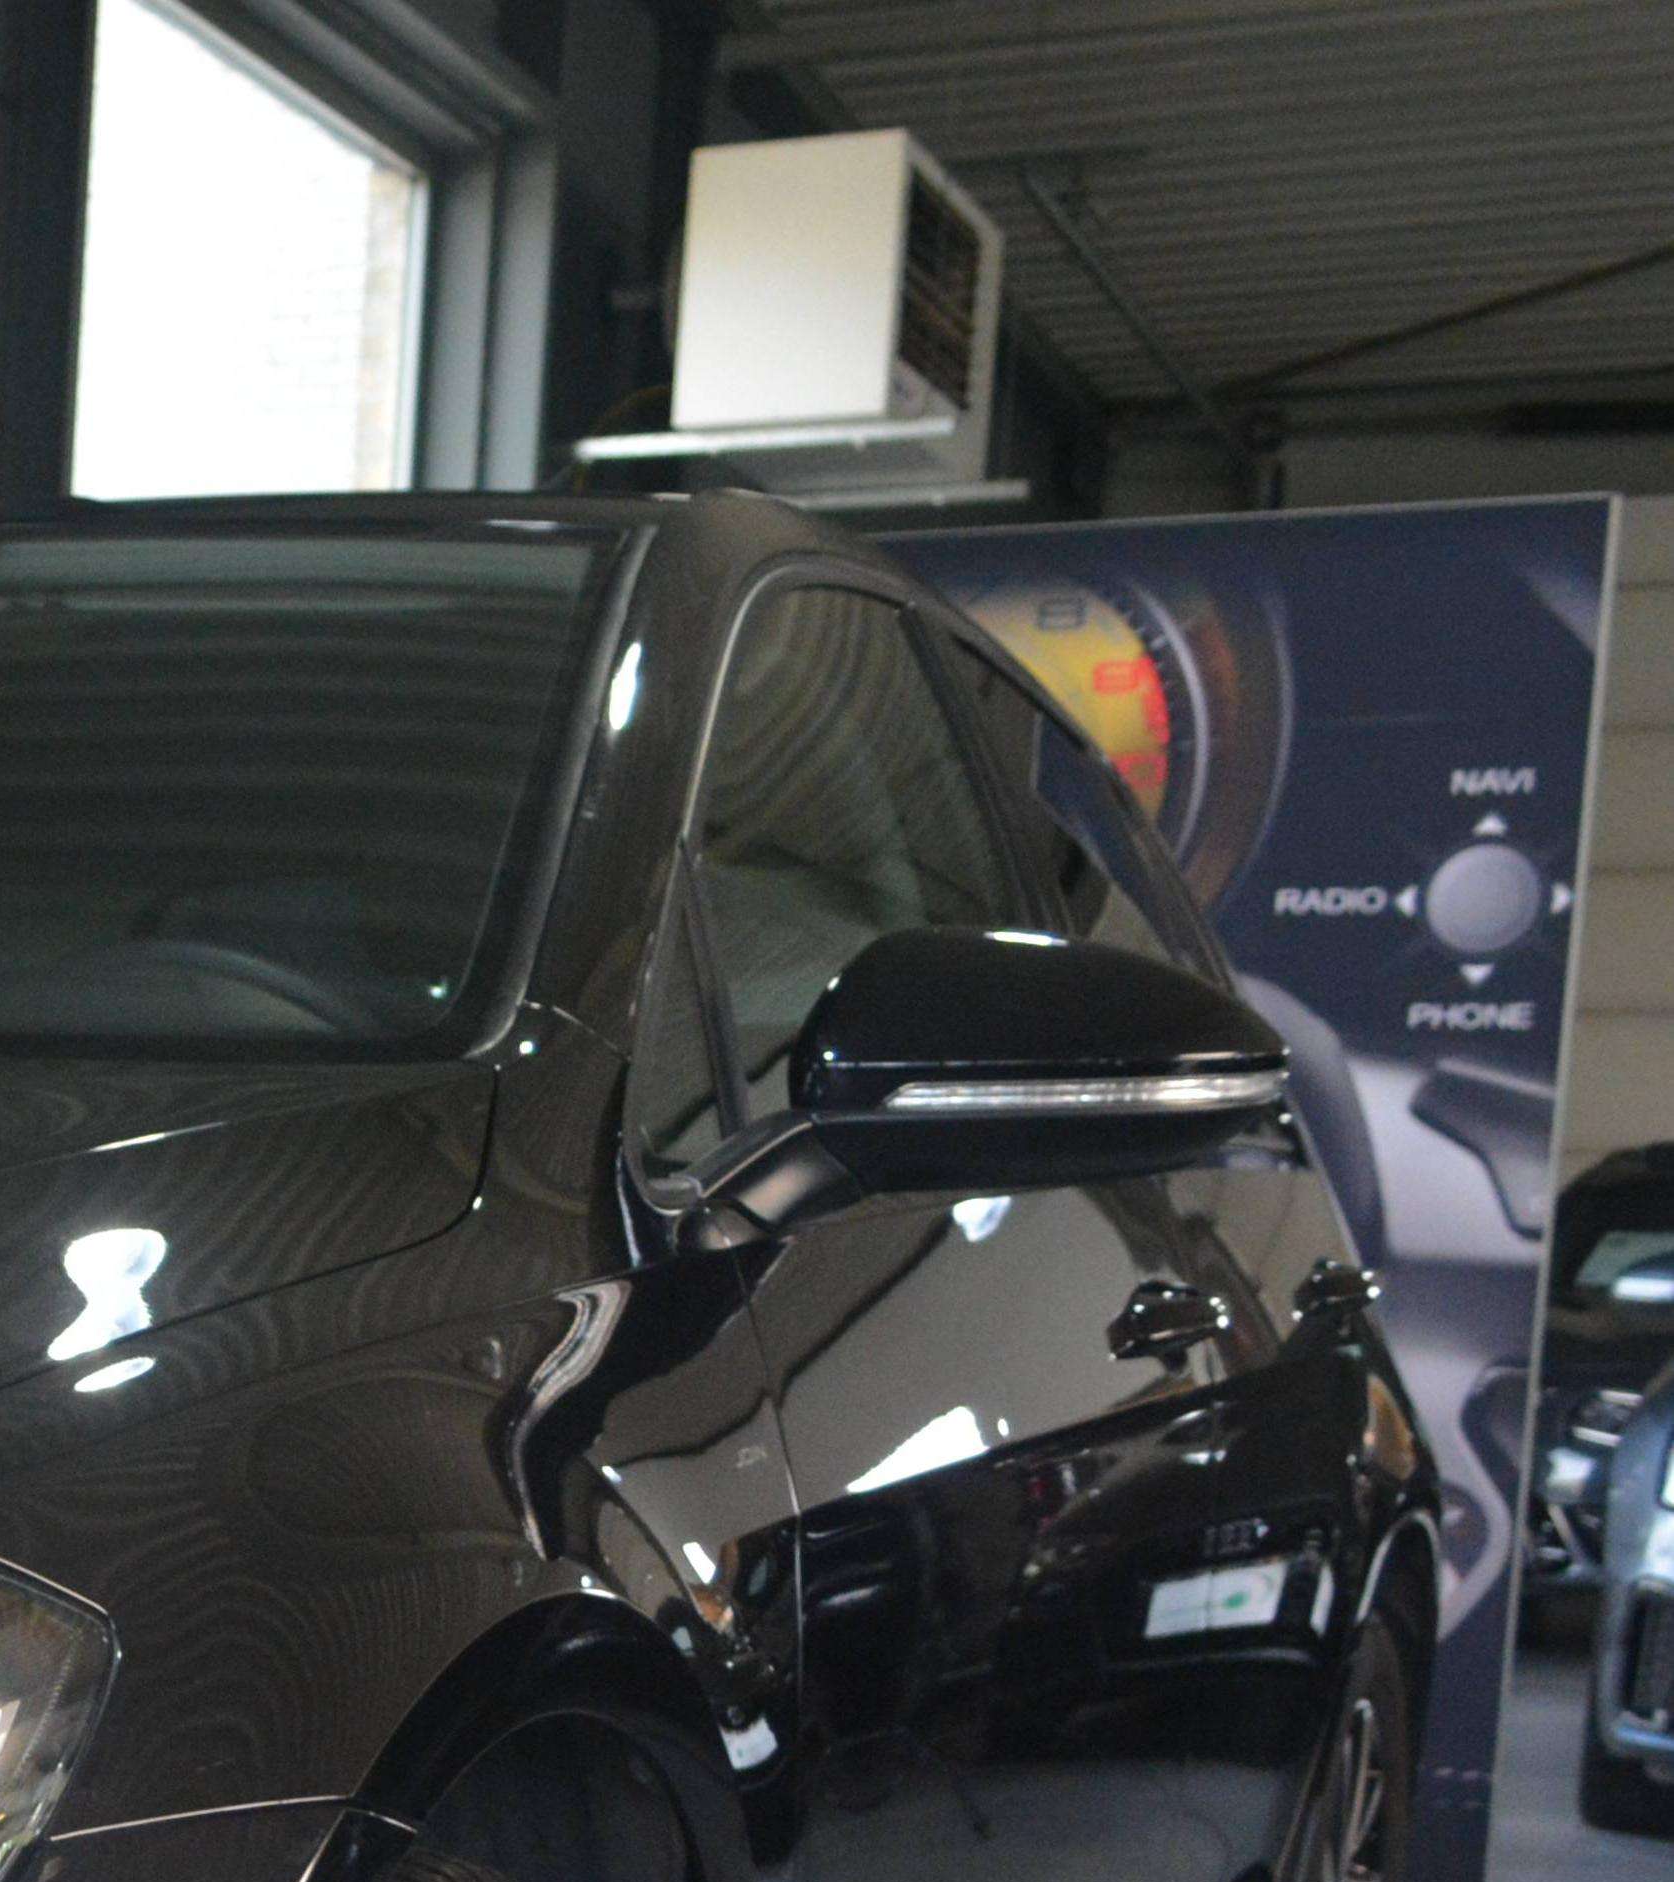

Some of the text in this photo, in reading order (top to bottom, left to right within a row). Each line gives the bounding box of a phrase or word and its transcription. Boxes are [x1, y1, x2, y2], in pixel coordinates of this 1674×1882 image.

[1450, 767, 1536, 796] NAVI
[1273, 886, 1388, 916] RADIO
[1406, 1002, 1536, 1031] PHONE
